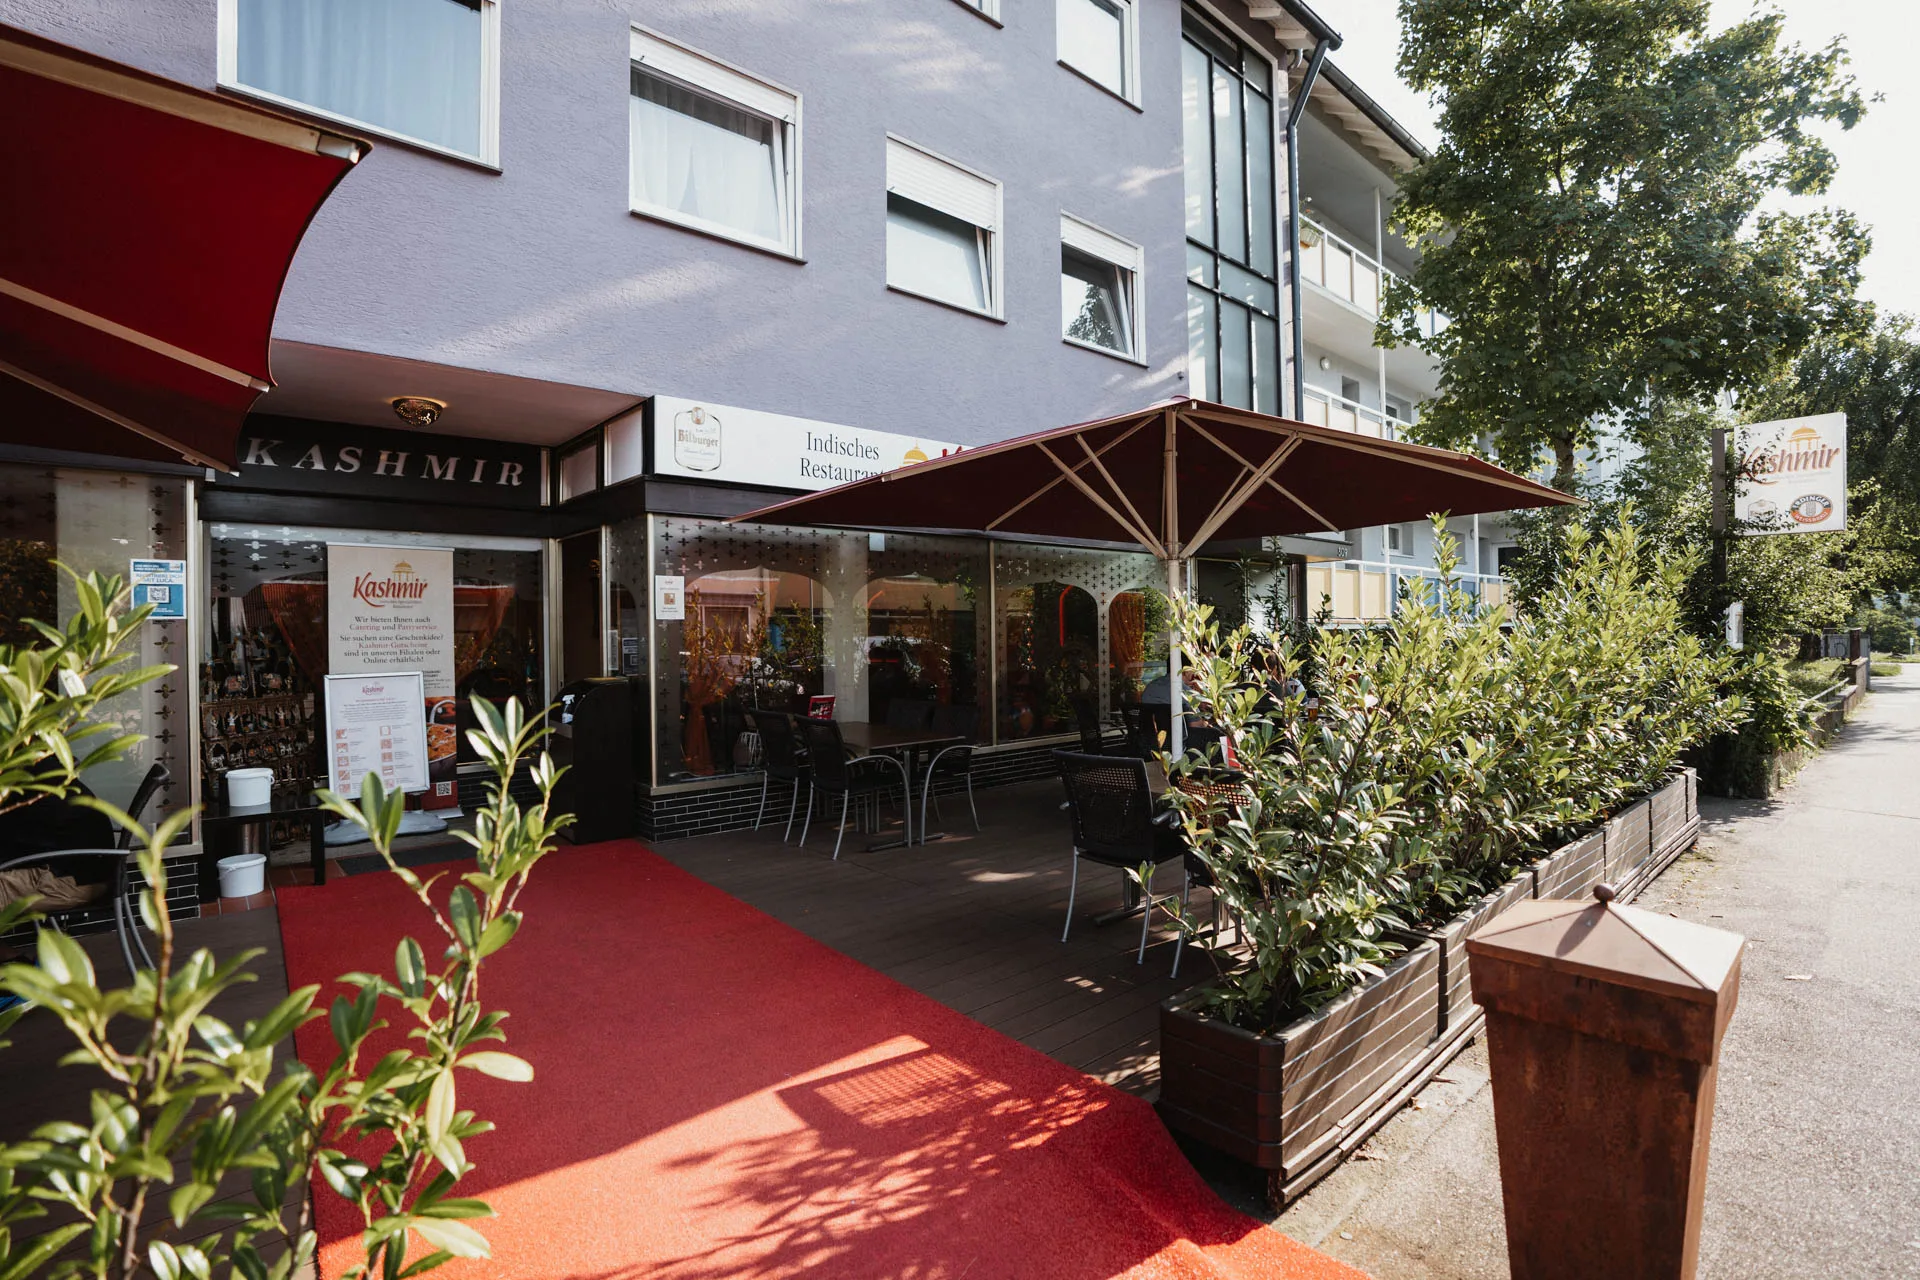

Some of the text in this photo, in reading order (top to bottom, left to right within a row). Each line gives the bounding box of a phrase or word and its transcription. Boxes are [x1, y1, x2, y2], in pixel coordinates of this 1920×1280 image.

[806, 432, 880, 460] Indisches
[241, 437, 524, 487] KASHMIR
[800, 457, 884, 482] Restaura
[353, 572, 428, 607] Kashmir
[363, 656, 389, 664] Online
